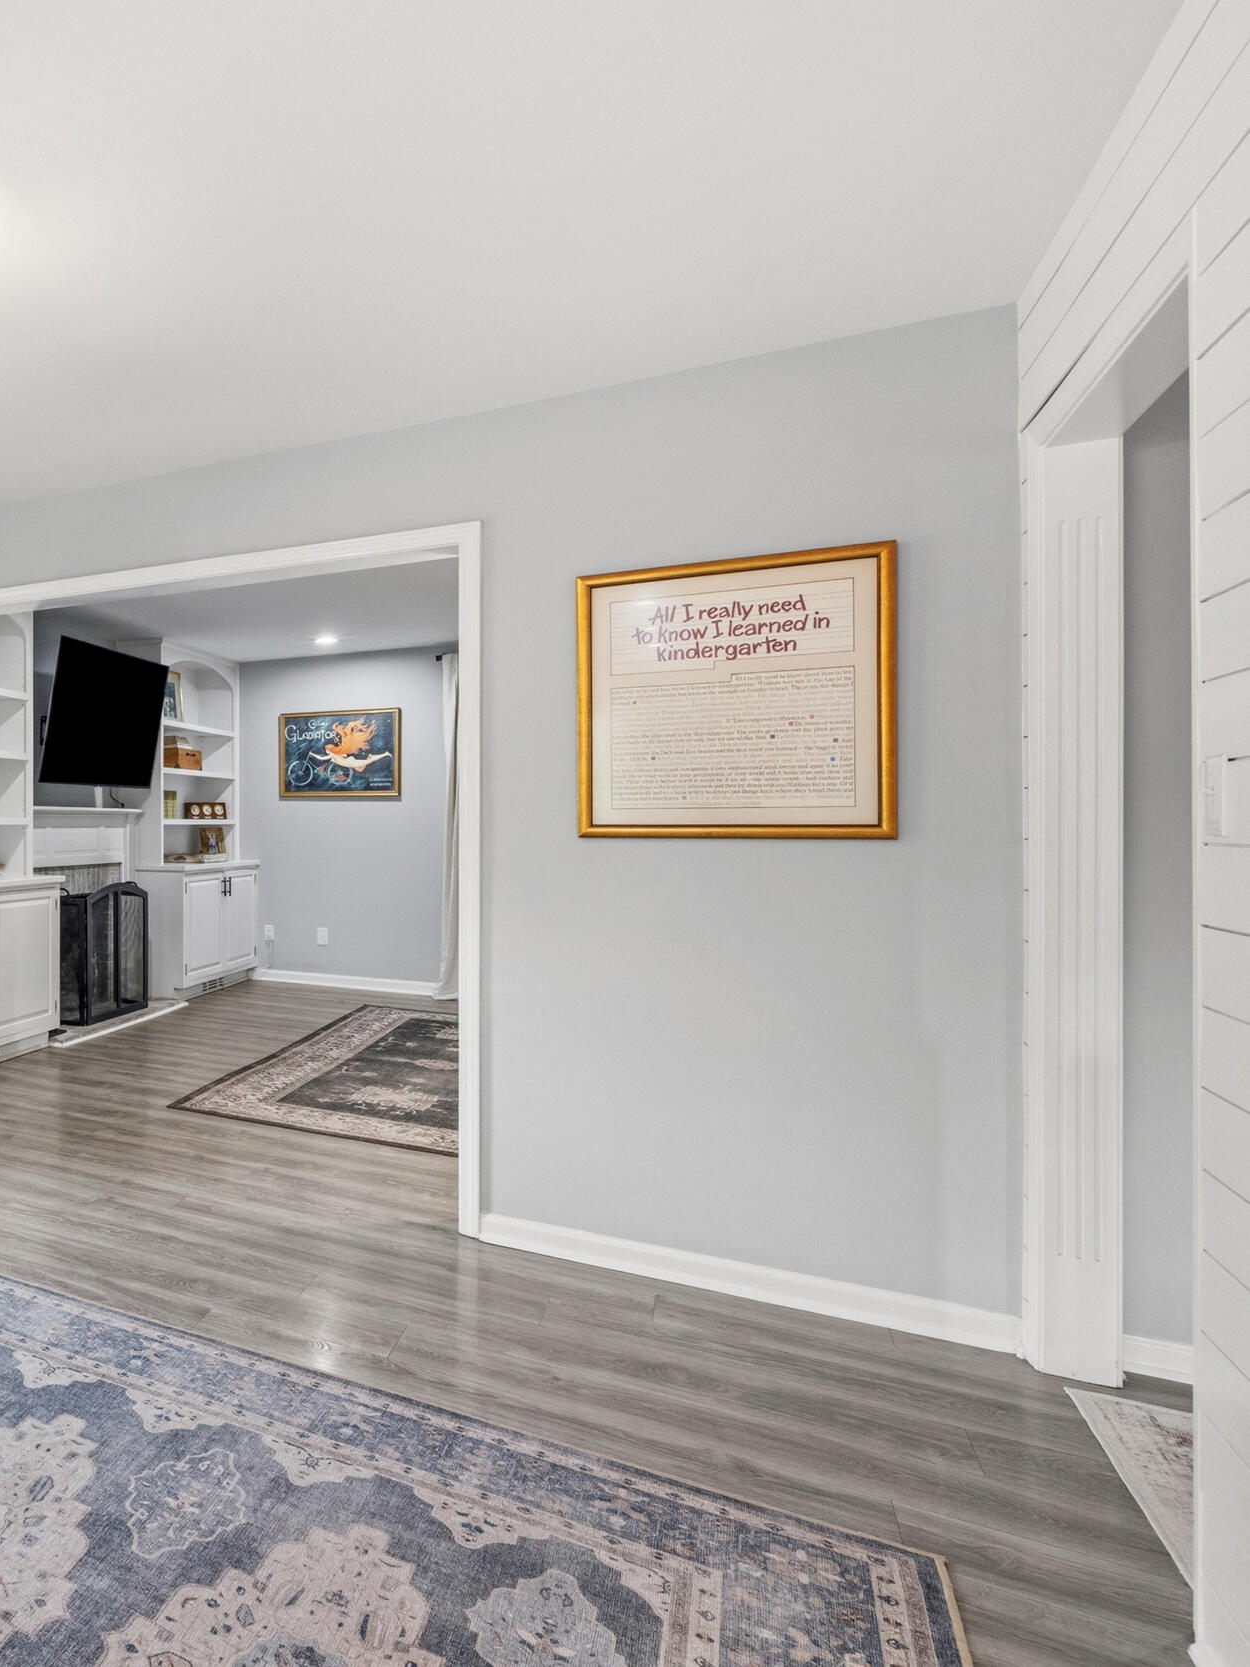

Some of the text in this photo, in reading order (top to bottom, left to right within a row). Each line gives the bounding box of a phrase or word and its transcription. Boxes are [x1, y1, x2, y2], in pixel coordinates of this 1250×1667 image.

[648, 593, 807, 625] All I really need
[631, 611, 830, 645] to know I learned in
[656, 636, 798, 661] kindergarten
